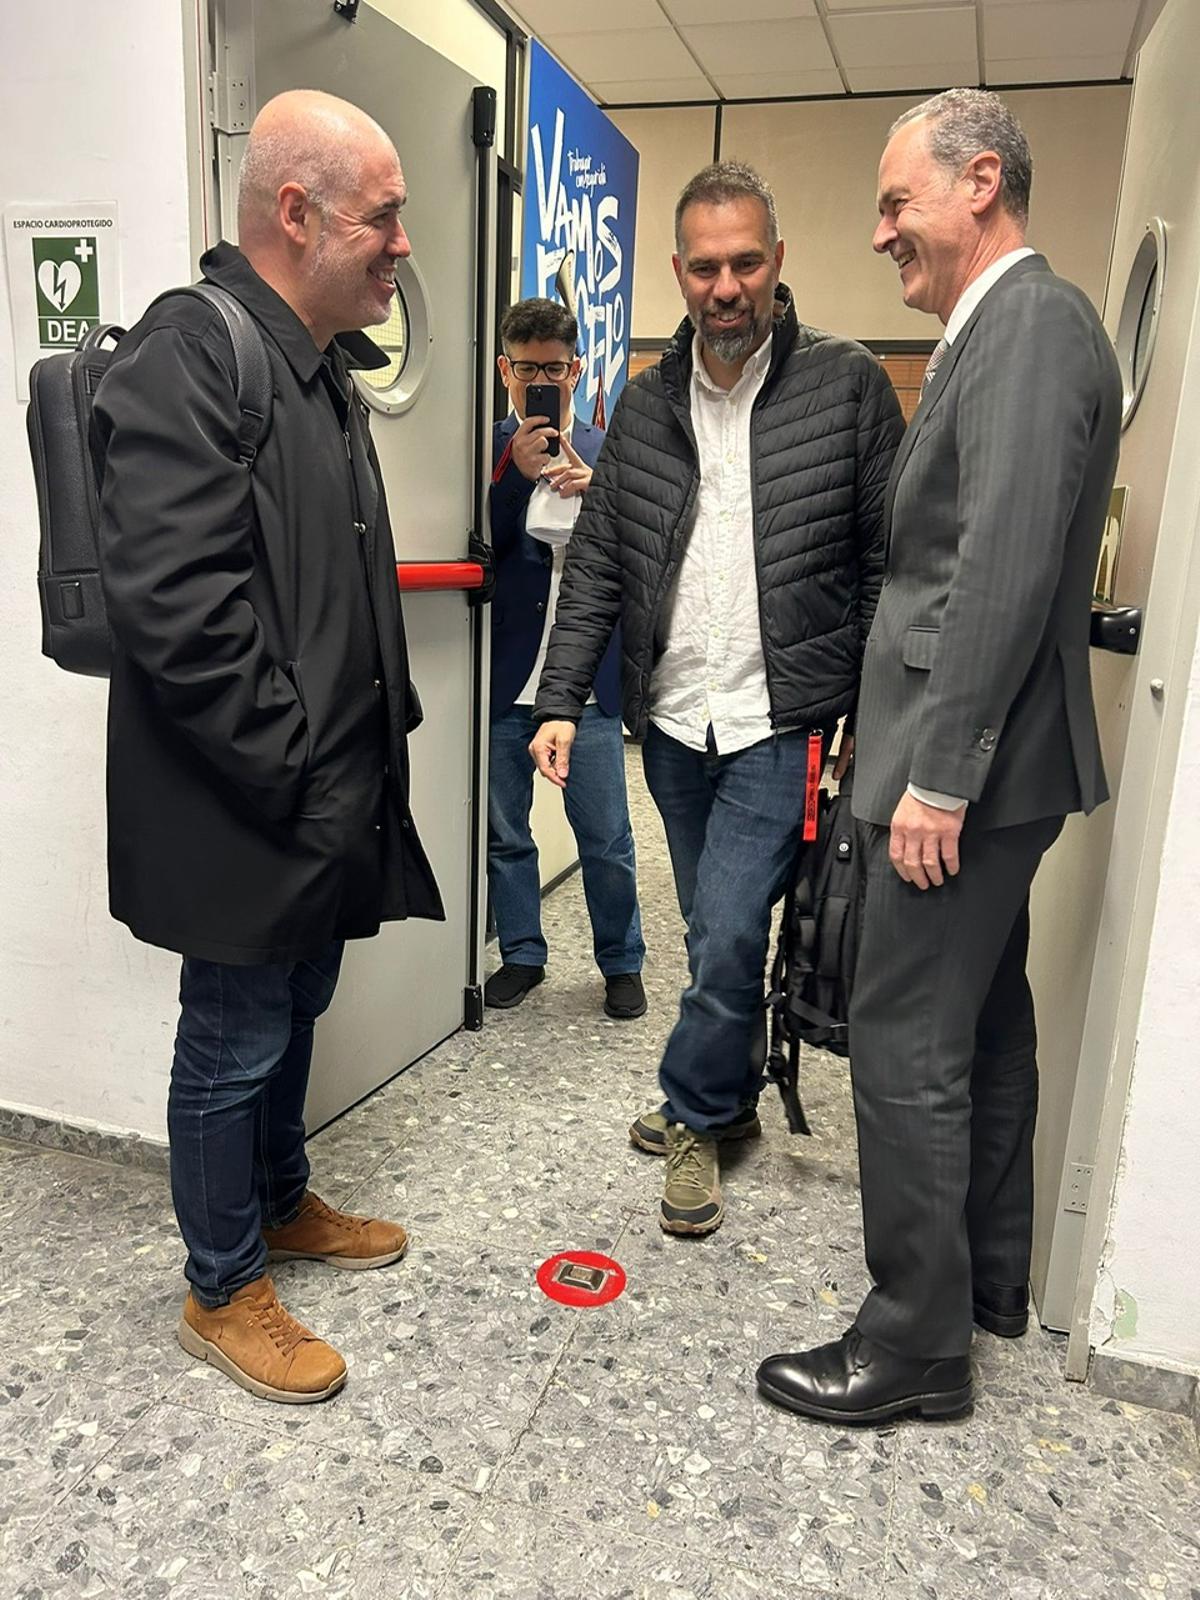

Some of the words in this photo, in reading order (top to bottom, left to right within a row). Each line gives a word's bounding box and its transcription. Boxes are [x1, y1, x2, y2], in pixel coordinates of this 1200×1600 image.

[531, 107, 623, 296] VAMOS
[13, 219, 43, 228] ESPACIO
[44, 219, 113, 228] CARDIOPROTEGIDO
[47, 320, 90, 342] DEA
